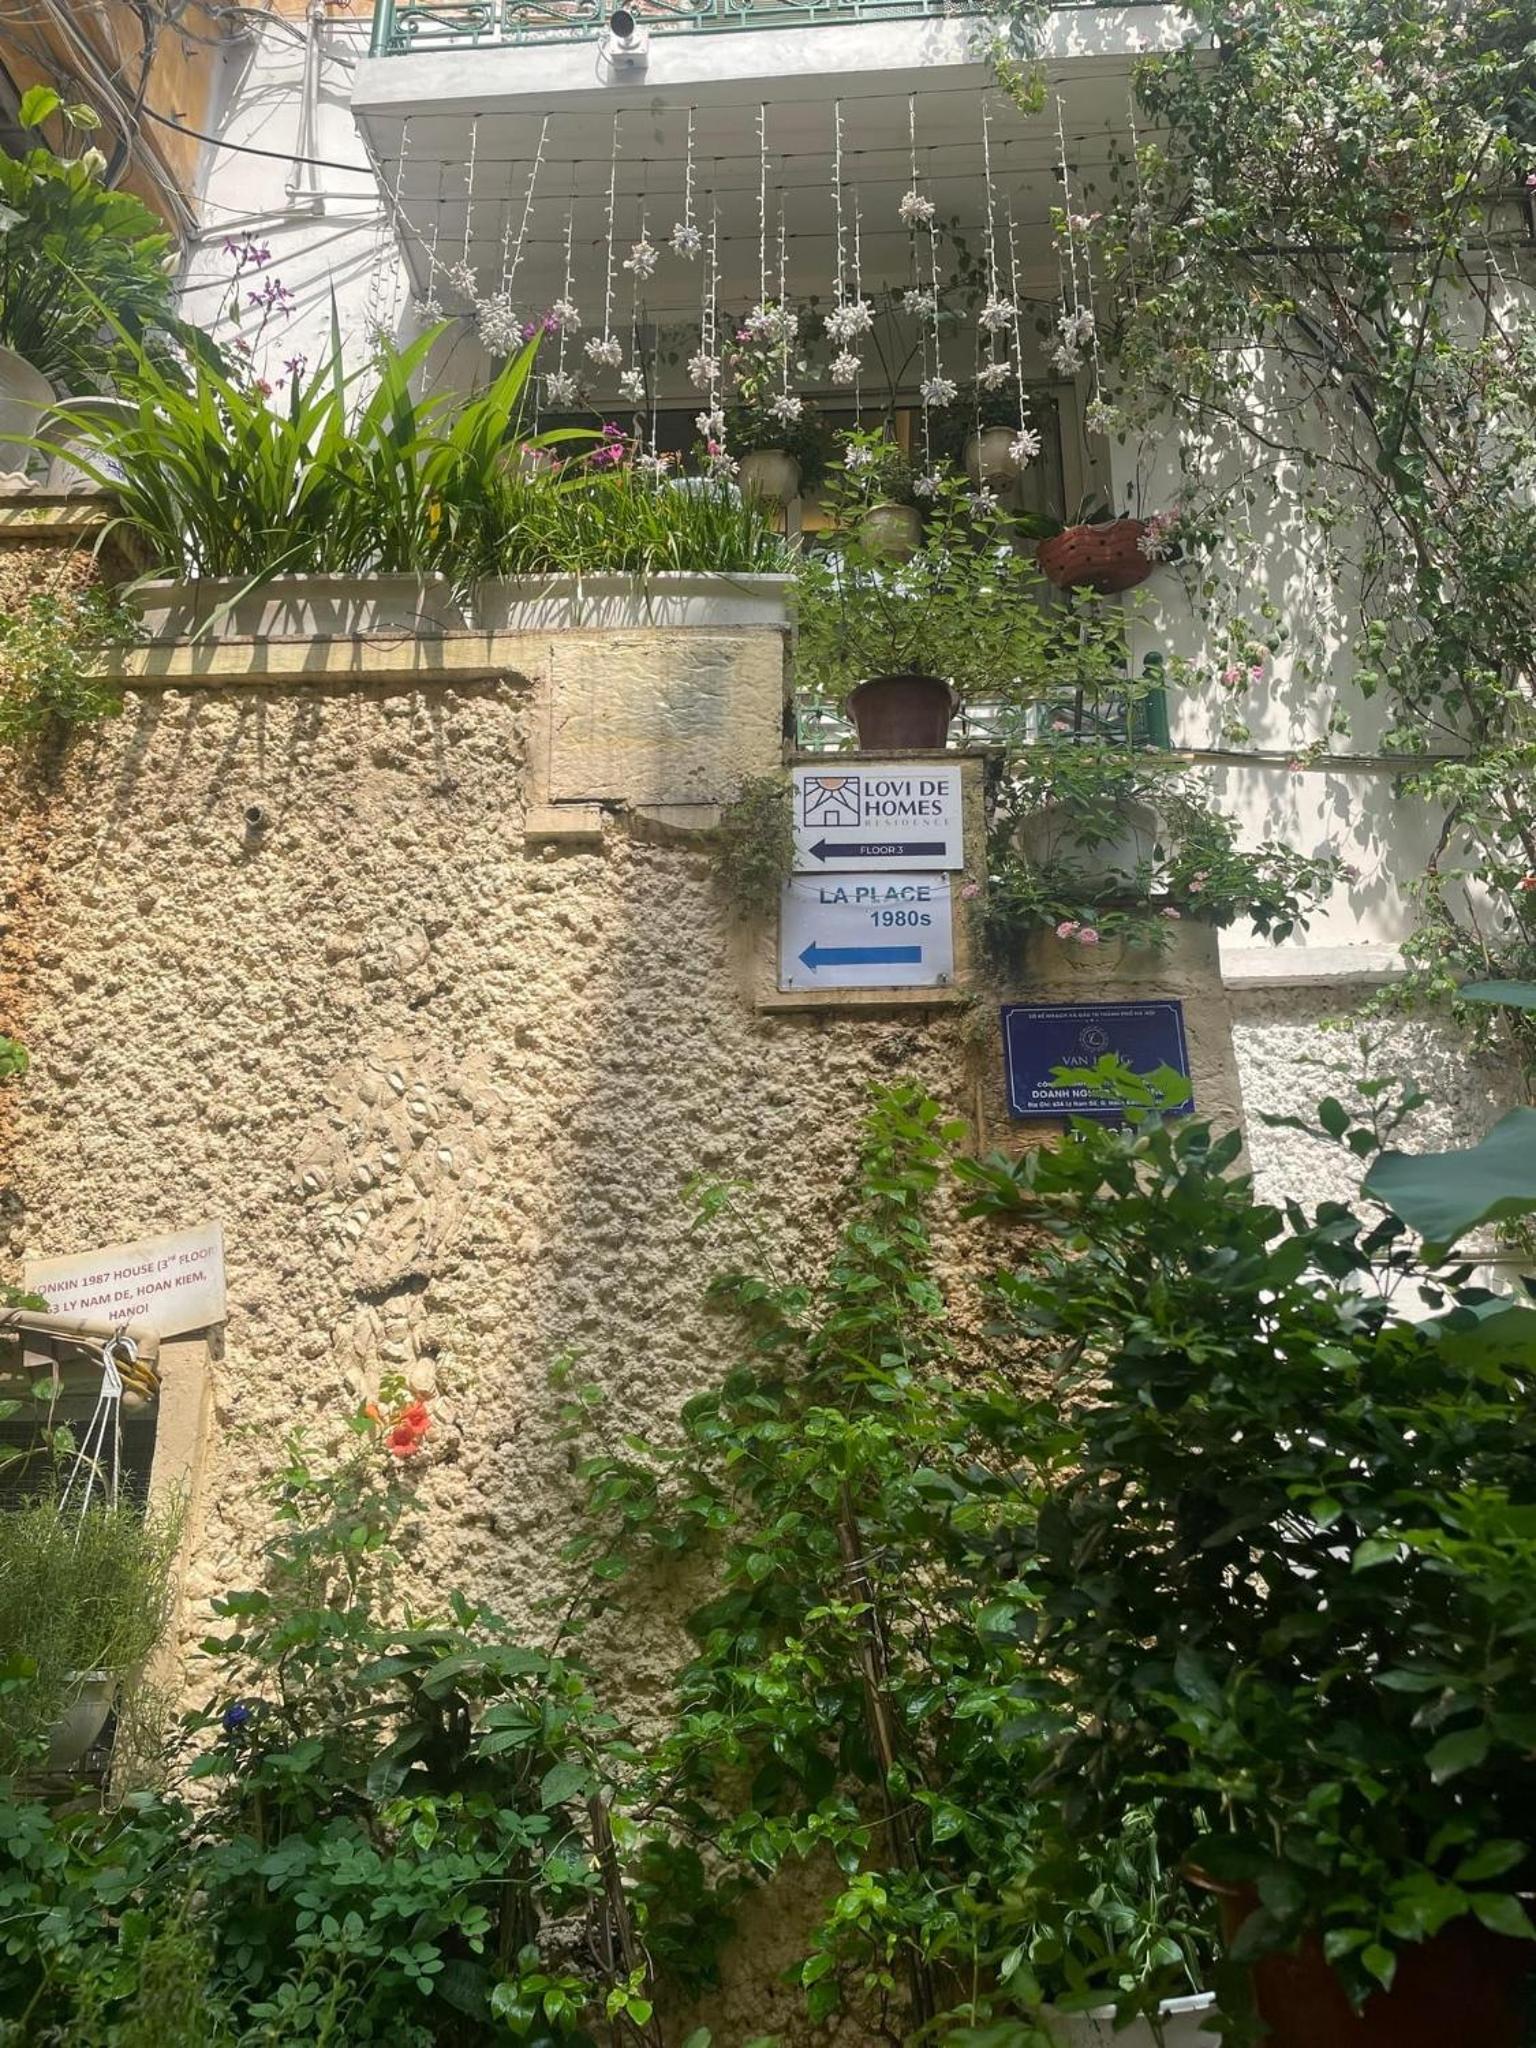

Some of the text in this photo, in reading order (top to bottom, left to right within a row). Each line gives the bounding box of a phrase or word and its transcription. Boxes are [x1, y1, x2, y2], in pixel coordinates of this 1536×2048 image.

[864, 780, 949, 797] LOVI DE
[865, 799, 943, 816] HOMES
[864, 818, 950, 827] RESIDENCE
[860, 845, 904, 855] FLOOR 3
[819, 886, 931, 905] LA PLACE
[870, 910, 932, 928] 1980s
[1031, 1089, 1070, 1099] DOANH
[82, 1272, 110, 1288] 1987
[113, 1262, 155, 1281] HOUSE
[63, 1299, 79, 1313] LY
[80, 1291, 112, 1309] NAM
[114, 1287, 134, 1303] DE,
[136, 1279, 172, 1298] HOAN
[174, 1270, 207, 1288] KIEM,
[108, 1303, 150, 1322] HANOI
